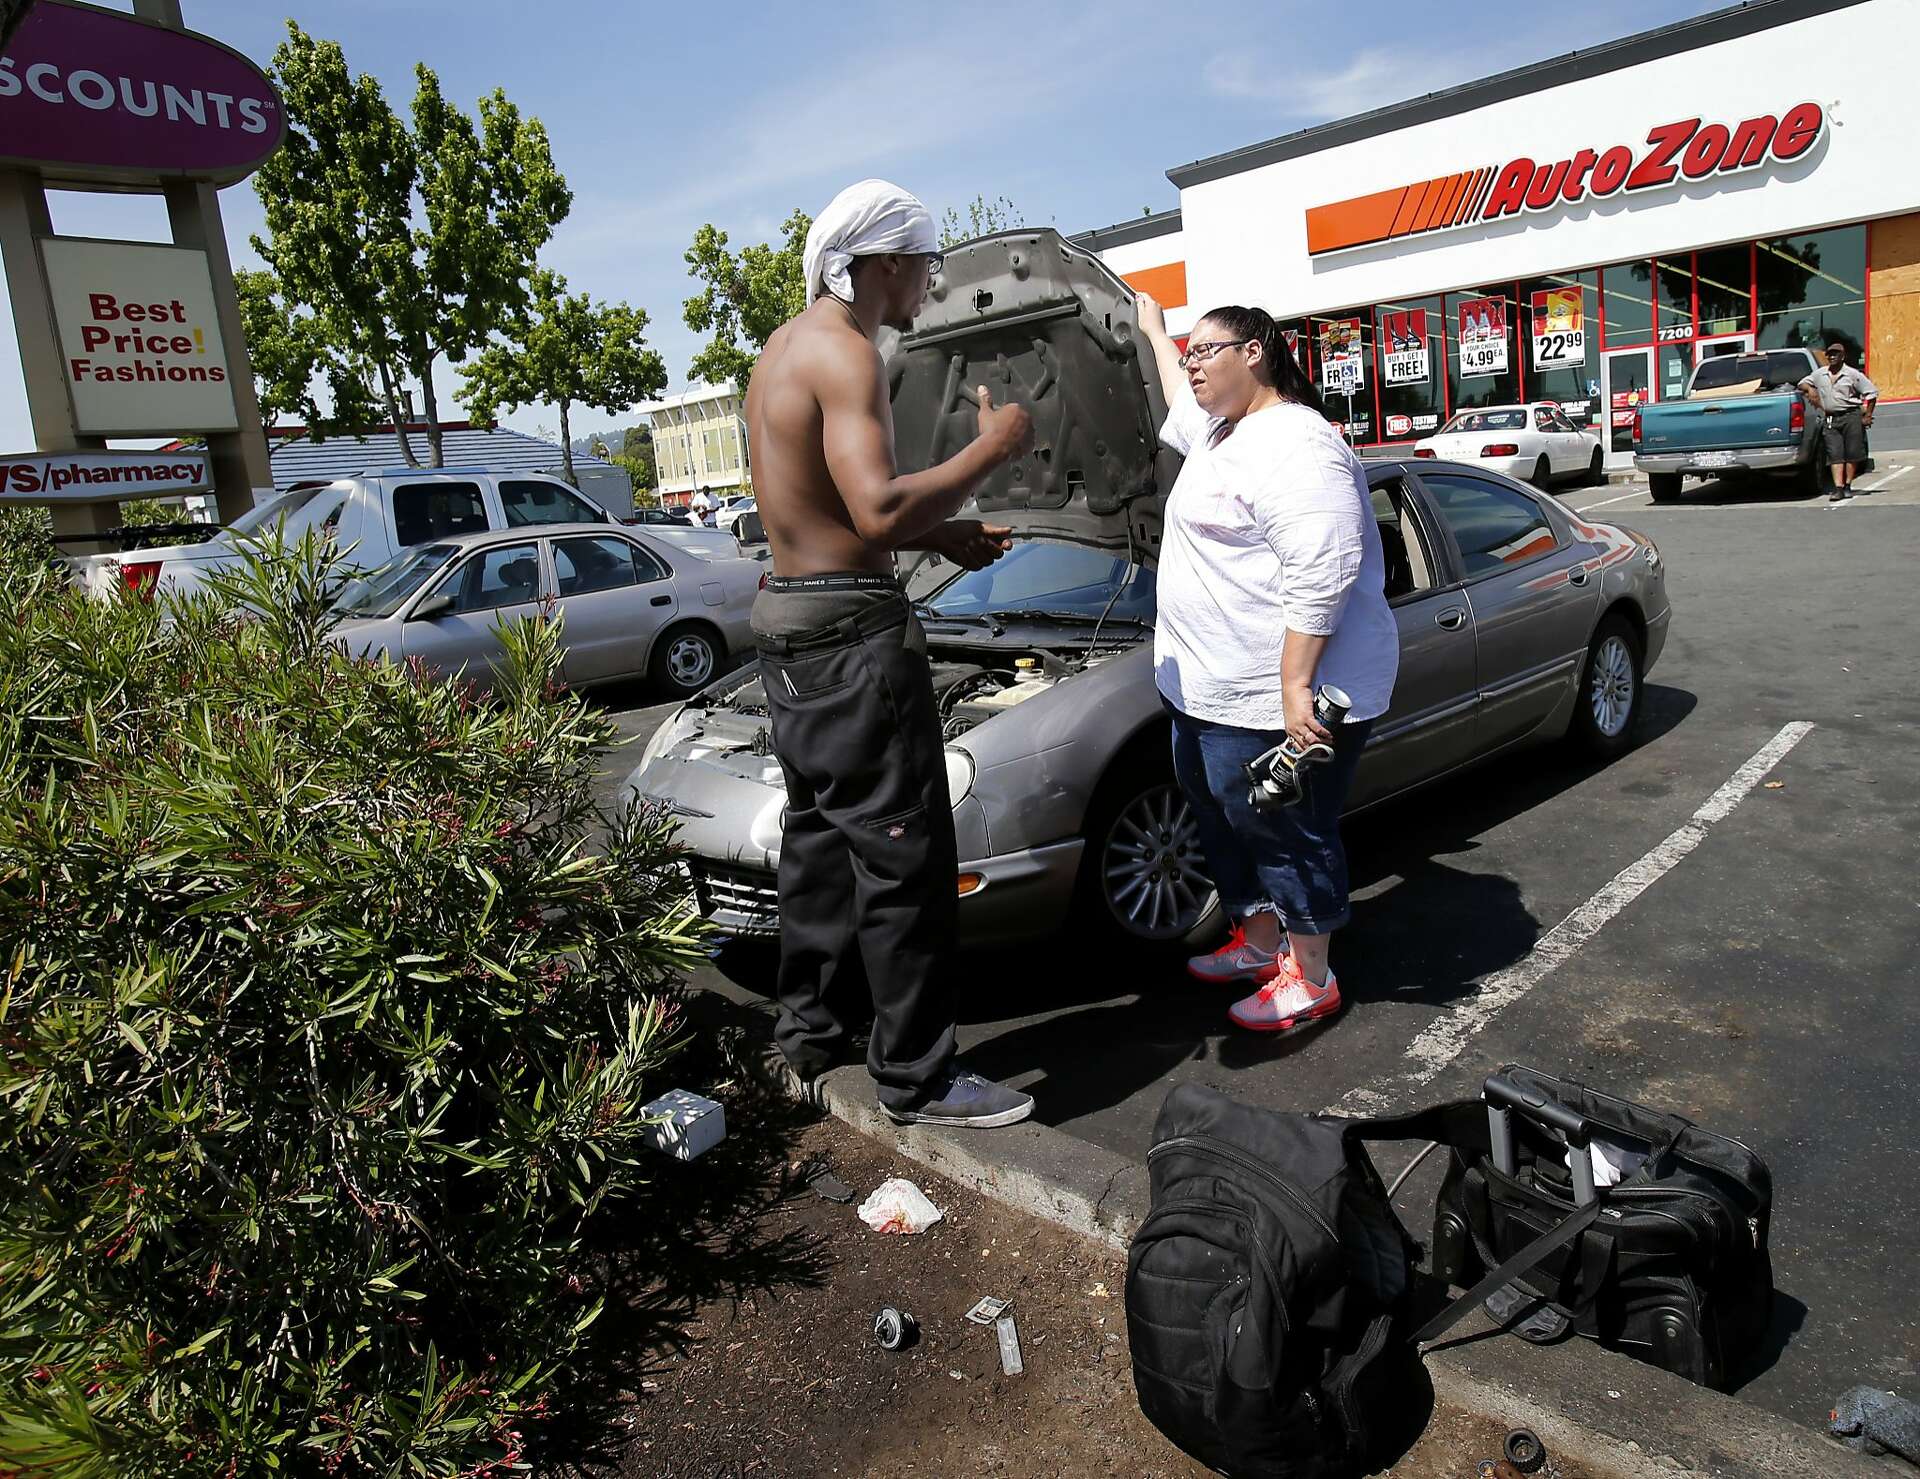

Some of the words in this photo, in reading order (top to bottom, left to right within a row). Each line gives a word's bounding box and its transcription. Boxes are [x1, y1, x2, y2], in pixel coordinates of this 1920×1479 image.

[1482, 102, 1823, 220] AutoZone
[89, 293, 186, 323] Best
[81, 325, 206, 354] Price!
[1658, 326, 1693, 341] 7200
[1388, 354, 1399, 363] BUY
[1407, 351, 1418, 360] GET
[1392, 360, 1423, 377] FREE!
[71, 359, 225, 382] Fashions
